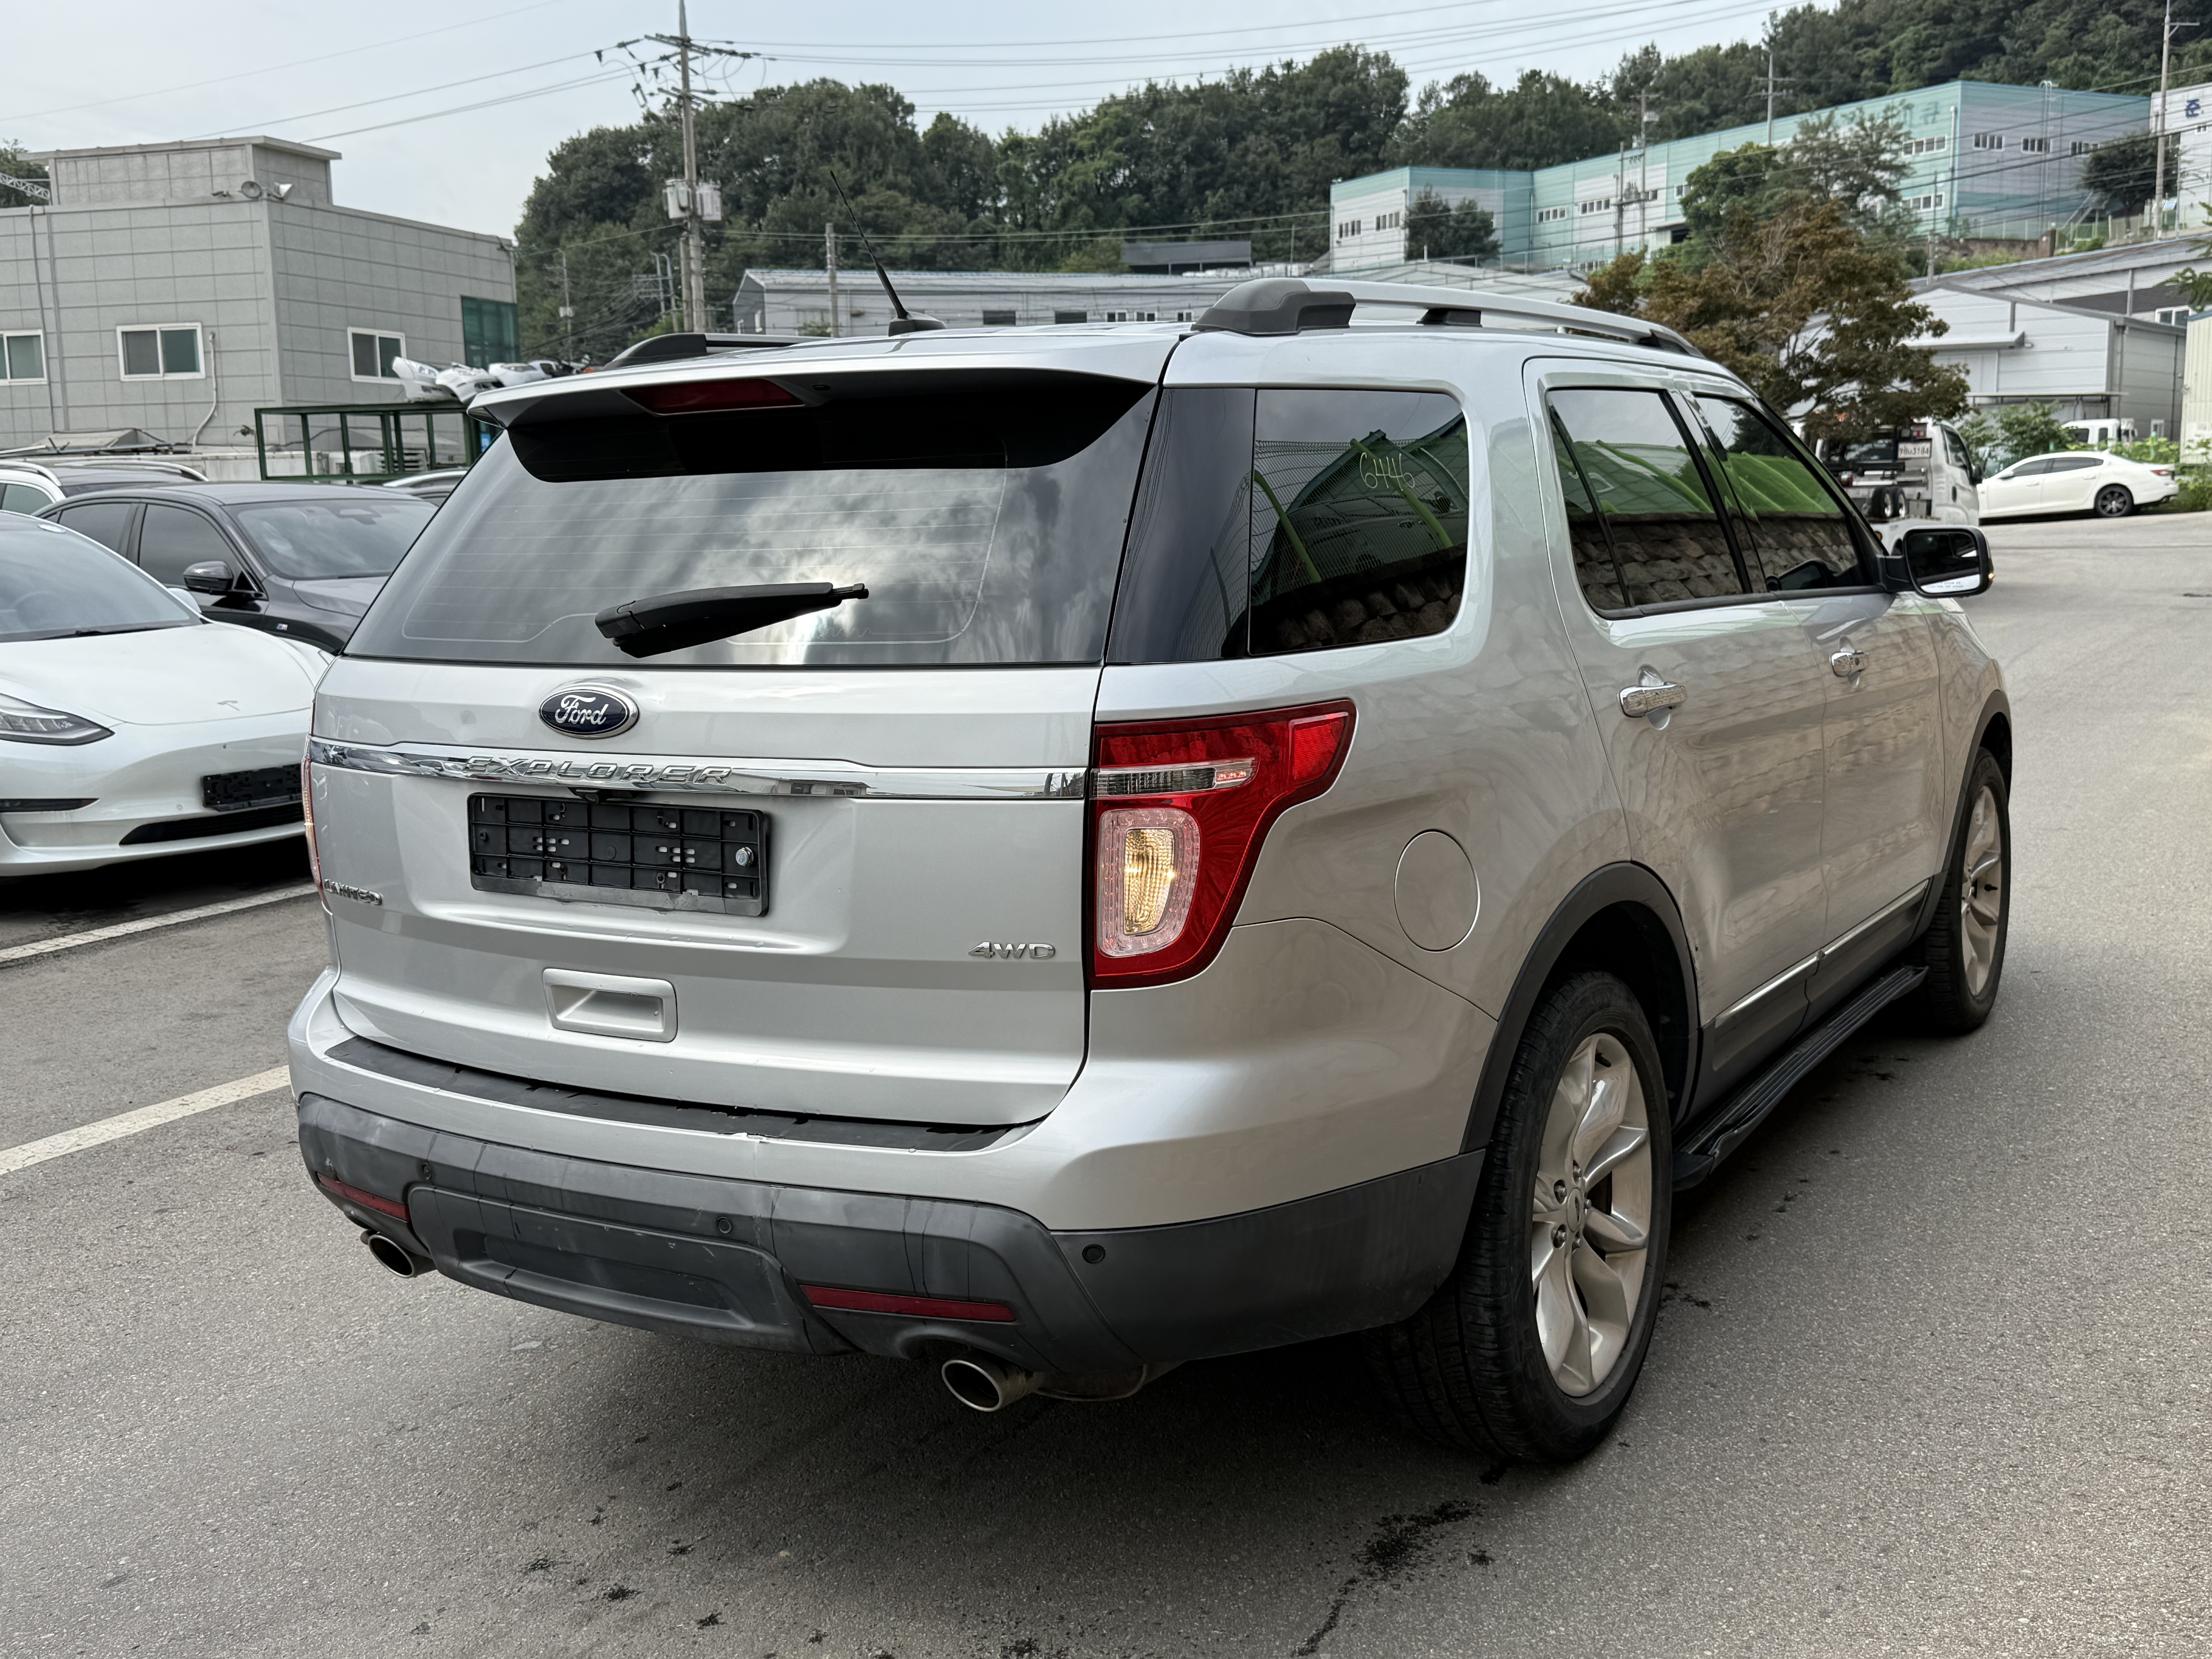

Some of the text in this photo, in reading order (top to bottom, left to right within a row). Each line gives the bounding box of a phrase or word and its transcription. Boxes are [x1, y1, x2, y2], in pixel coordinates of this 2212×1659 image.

[1360, 452, 1415, 491] 6446
[555, 695, 609, 725] Ford
[465, 756, 732, 785] EXPLORER
[968, 941, 1055, 959] 4WD
